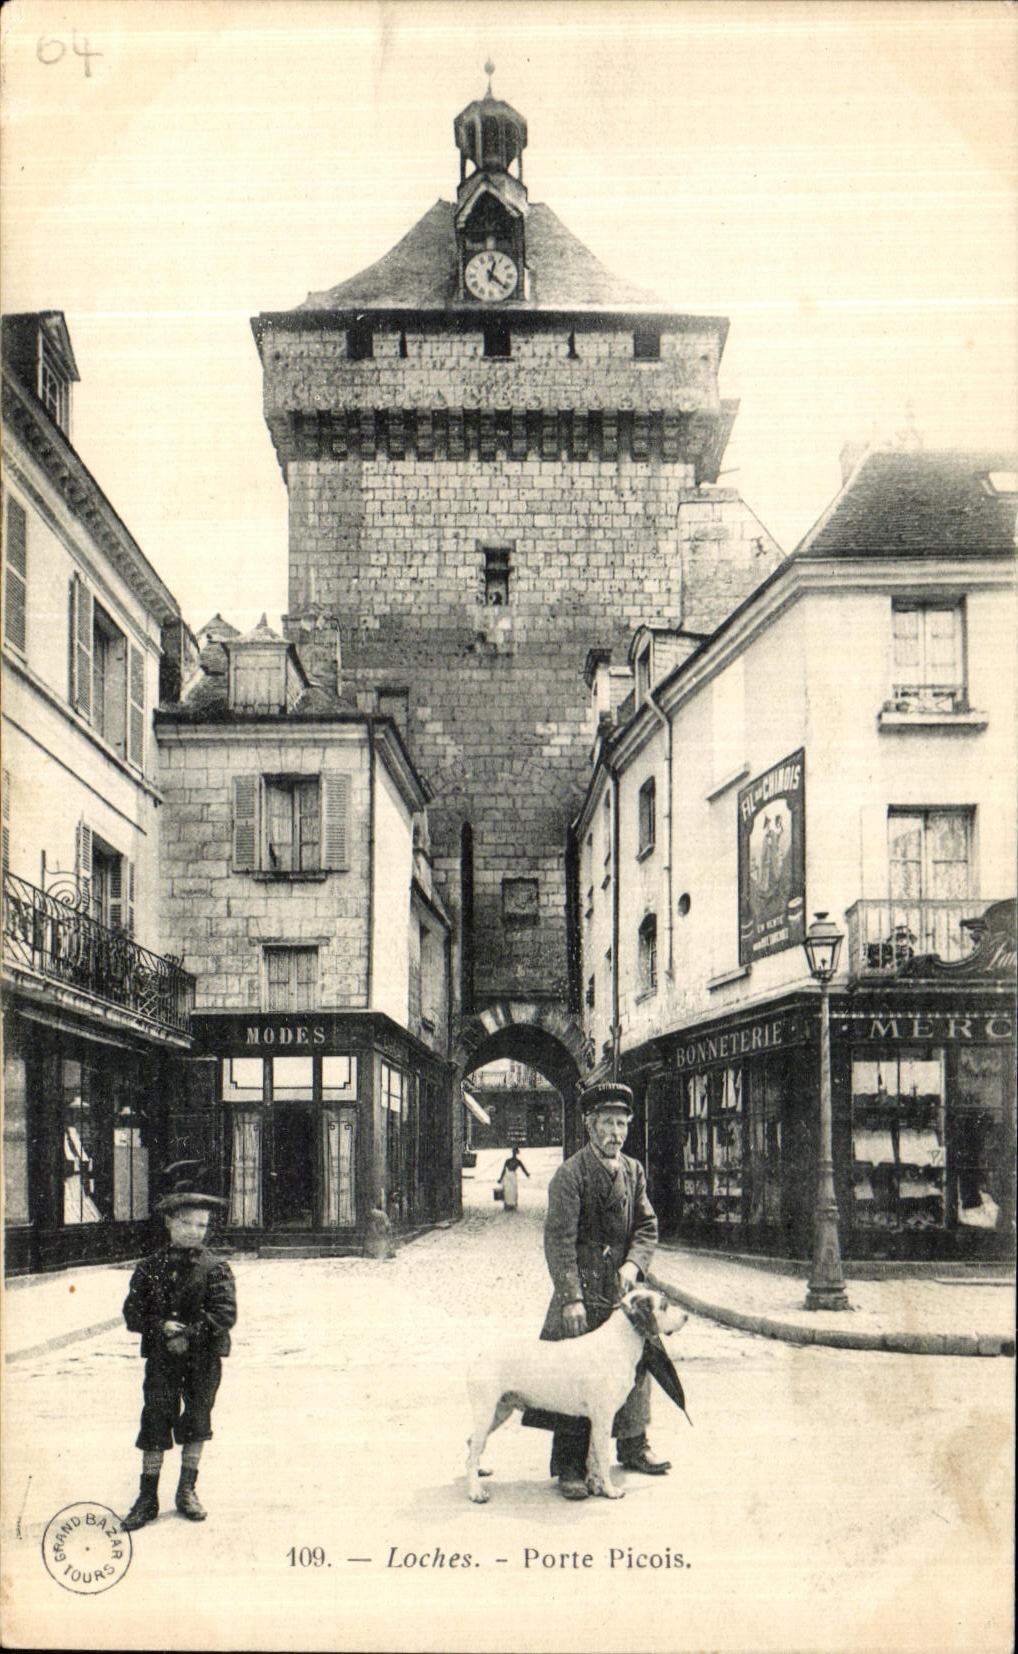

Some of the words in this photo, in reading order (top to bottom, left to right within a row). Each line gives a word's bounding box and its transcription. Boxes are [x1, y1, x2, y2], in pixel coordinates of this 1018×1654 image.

[36, 27, 104, 78] 64
[762, 764, 801, 801] CHINOIS
[246, 1026, 326, 1044] MODES
[676, 1020, 783, 1069] BONNETERIE
[869, 1018, 1013, 1039] MERC
